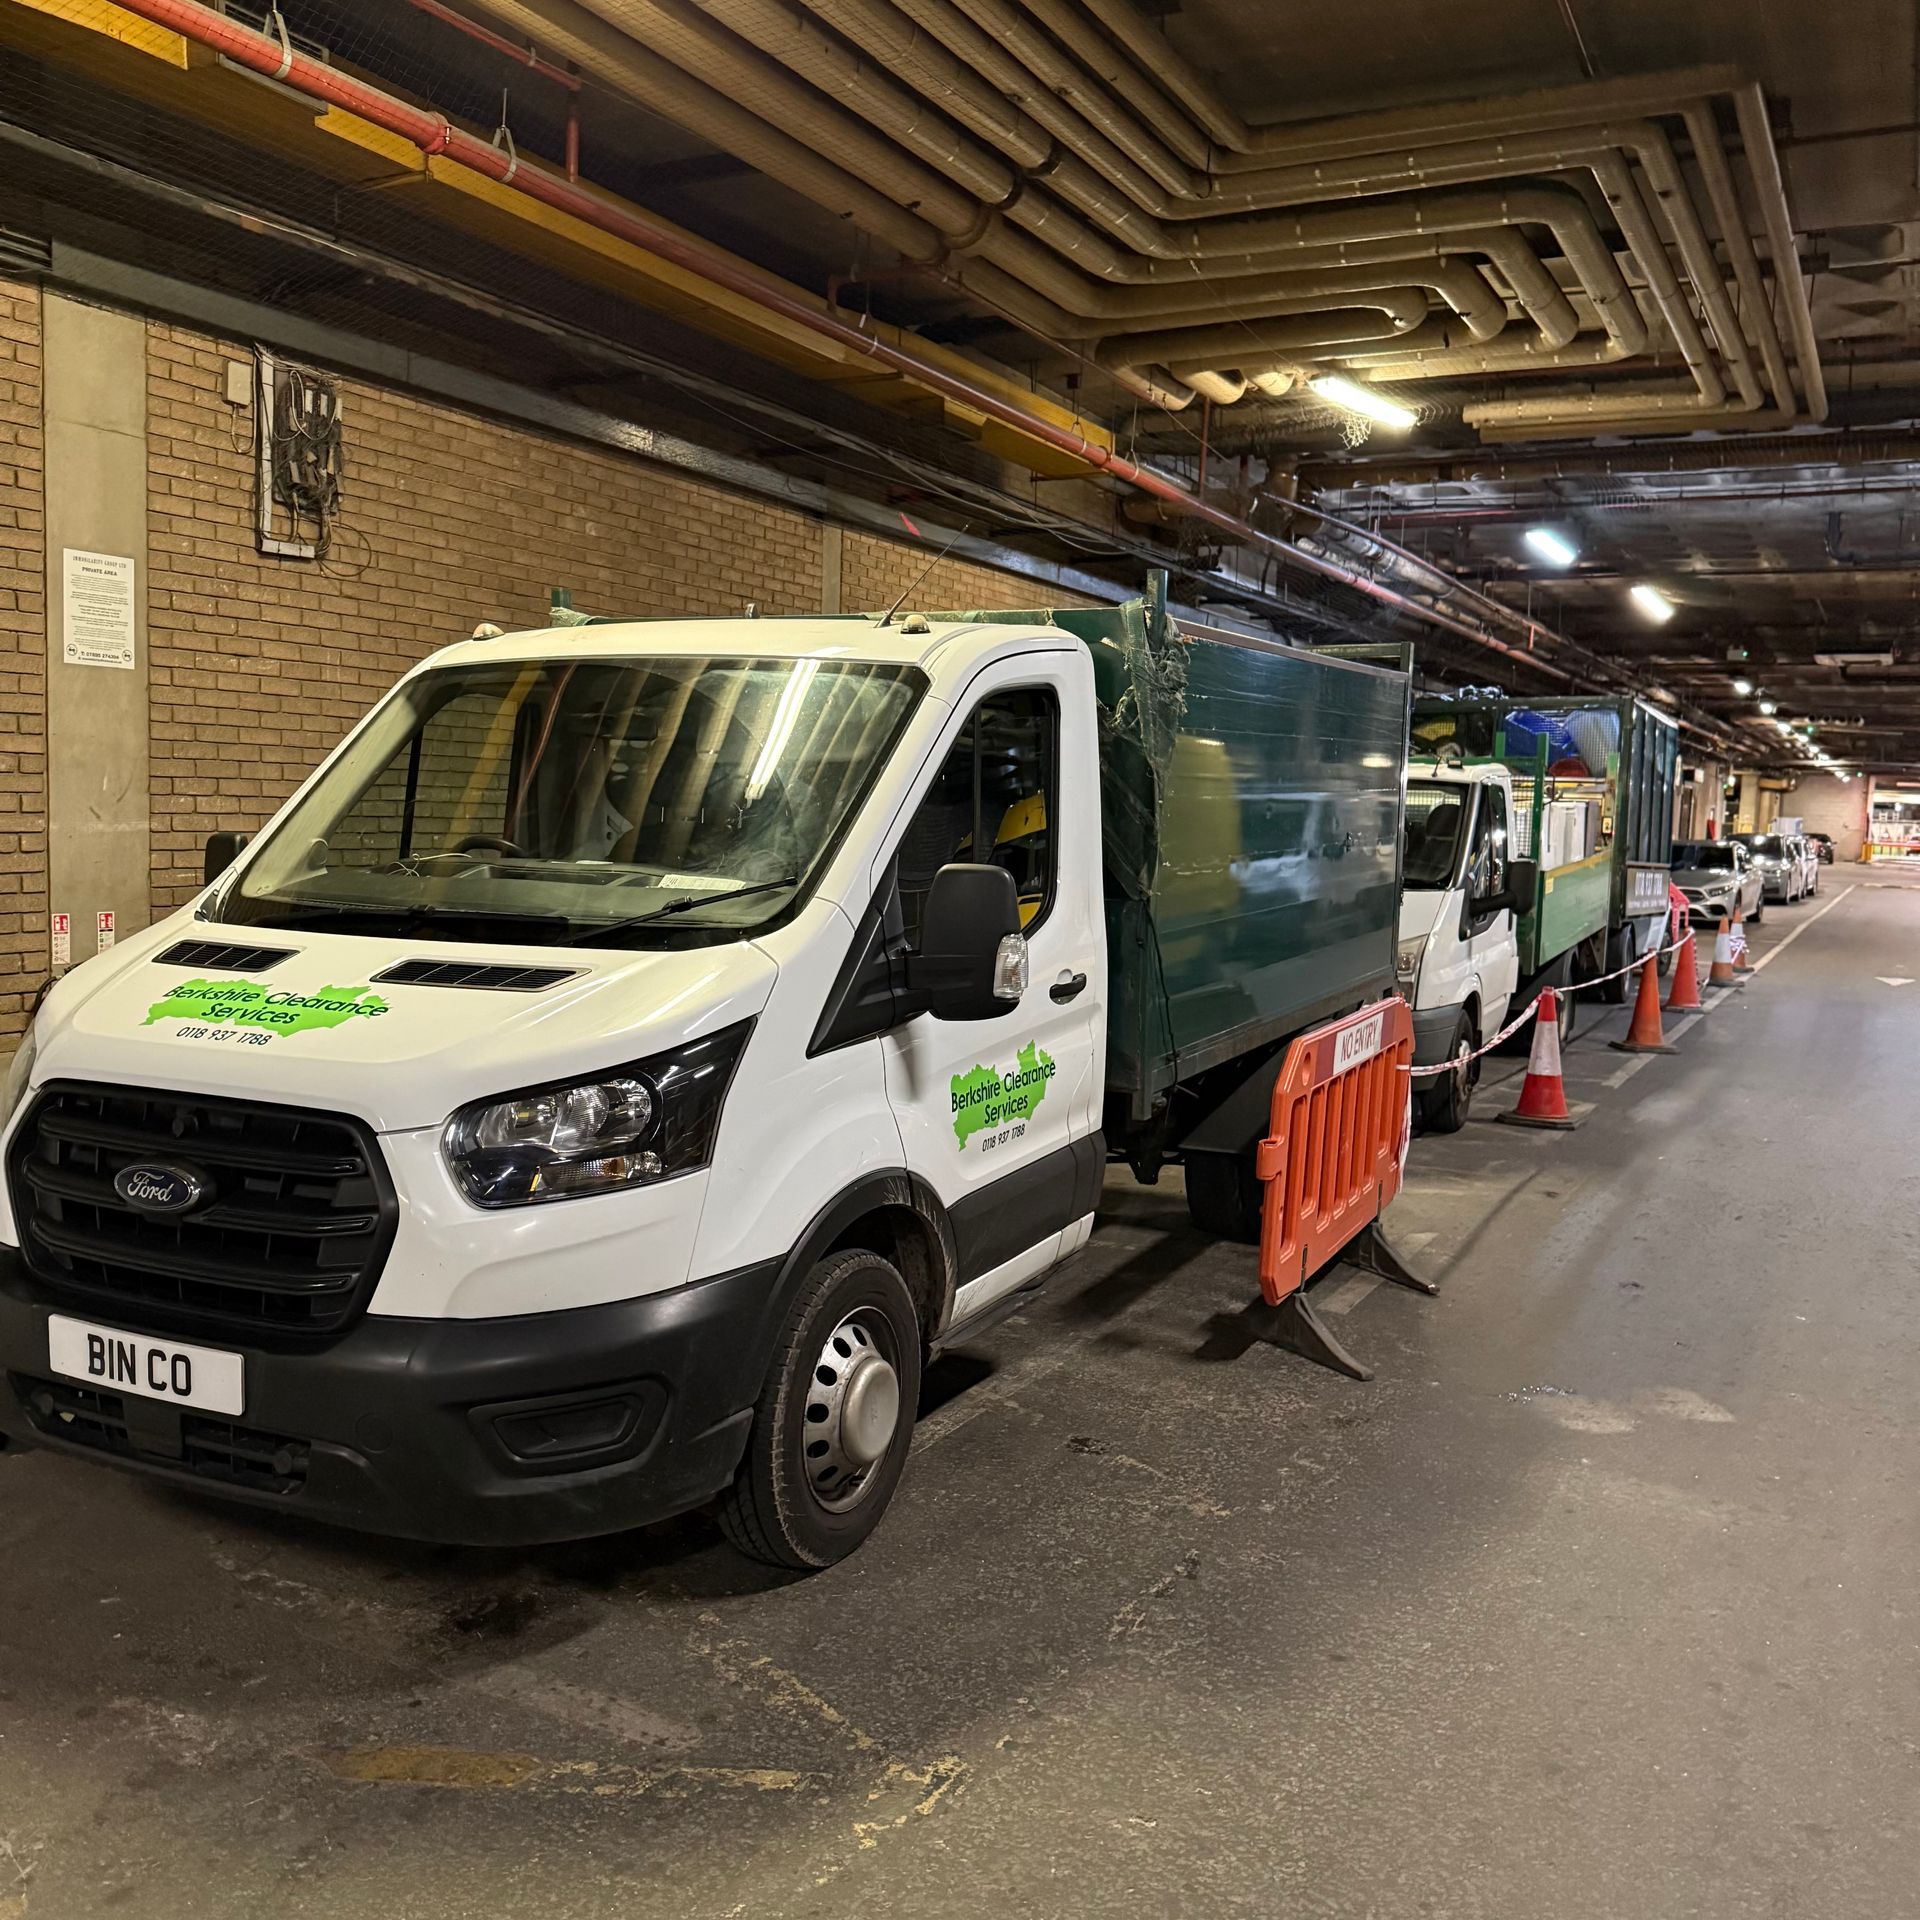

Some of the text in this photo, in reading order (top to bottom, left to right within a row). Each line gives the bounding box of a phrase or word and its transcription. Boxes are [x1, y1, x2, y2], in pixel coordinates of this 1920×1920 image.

[81, 566, 103, 574] PRIVATE
[162, 985, 389, 1016] Berkshire Clearance
[201, 1002, 301, 1024] Services
[176, 1027, 272, 1046] 0118 937 1788
[1341, 1018, 1379, 1063] NO ENTRY
[951, 1060, 1056, 1113] Berkshire Clearance
[984, 1094, 1028, 1124] Services
[982, 1123, 1026, 1152] 0118 937 1788
[127, 1171, 175, 1202] Ford
[87, 1333, 192, 1397] BIN CO
